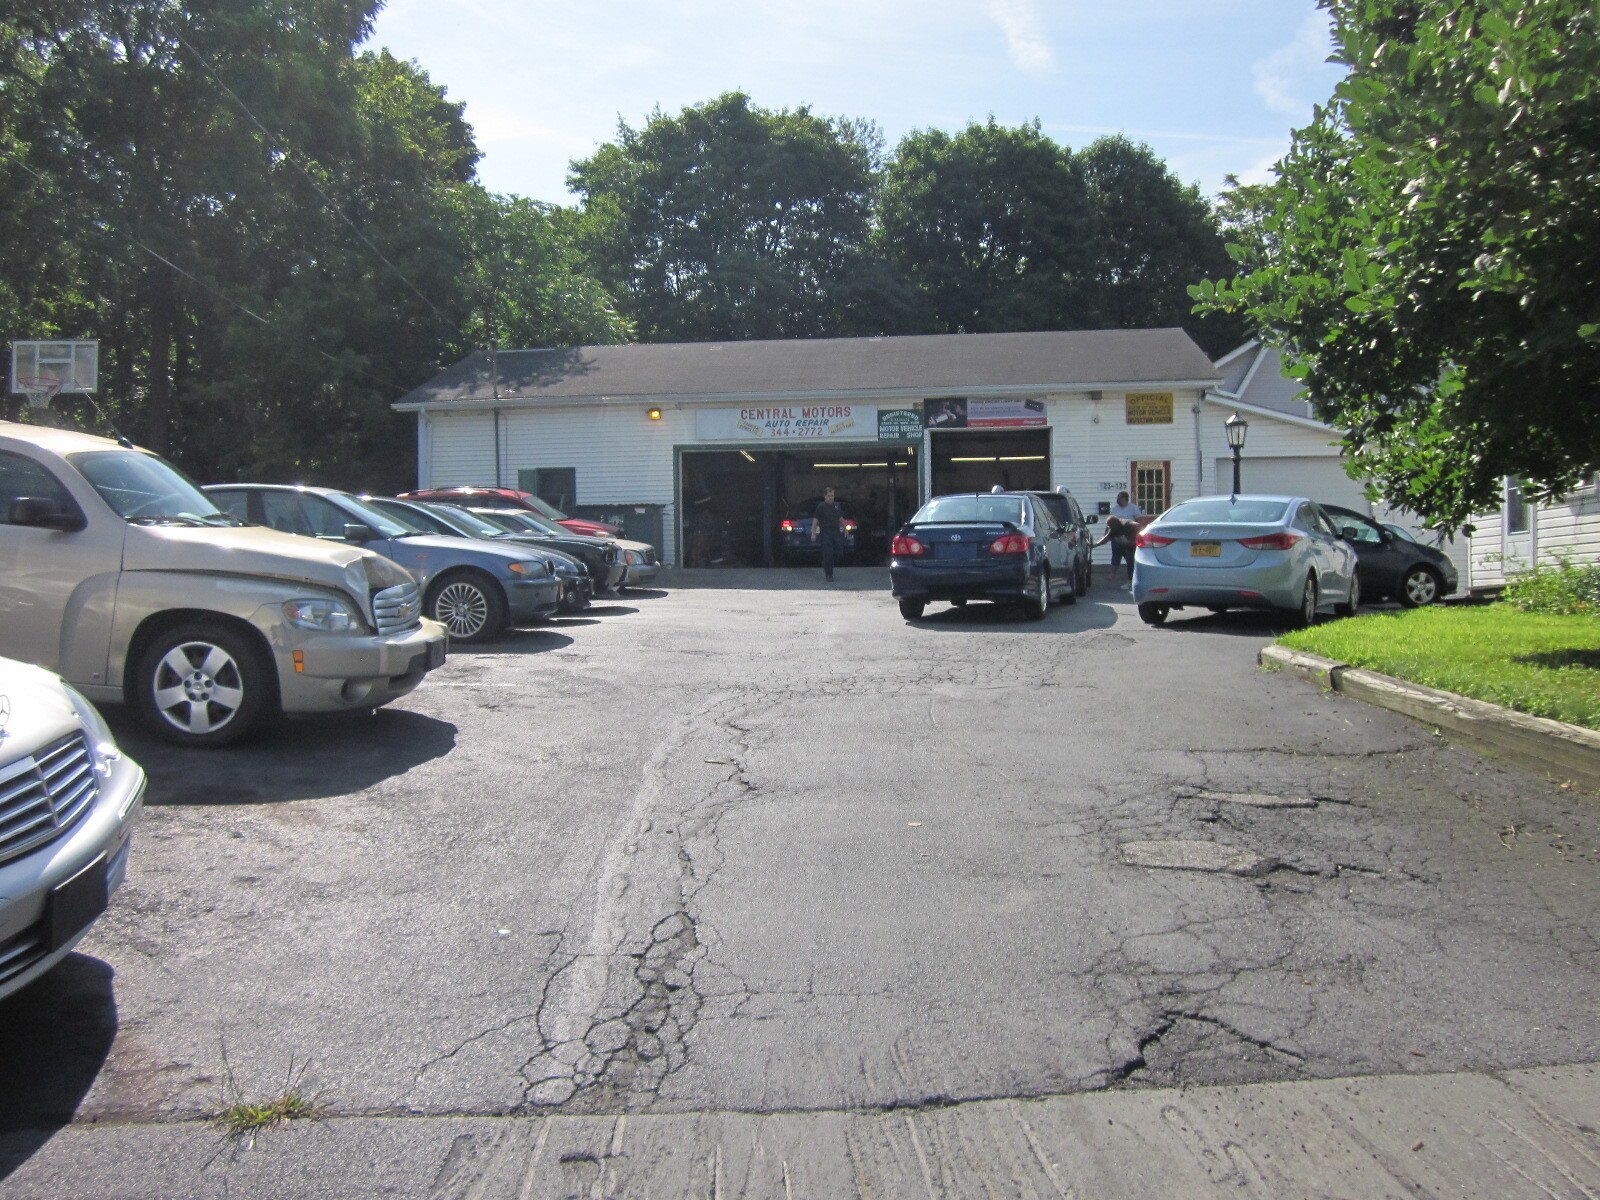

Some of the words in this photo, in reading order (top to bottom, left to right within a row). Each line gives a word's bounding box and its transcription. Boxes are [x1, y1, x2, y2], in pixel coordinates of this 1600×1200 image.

[1130, 394, 1168, 404] OFFICIAL
[740, 408, 796, 420] CENTRAL
[802, 406, 851, 419] MOTORS
[882, 410, 919, 421] REGISTERED
[764, 419, 790, 428] AUTO
[795, 418, 830, 427] REPAIR
[900, 424, 923, 432] VEHICLE
[906, 431, 923, 439] SHOP
